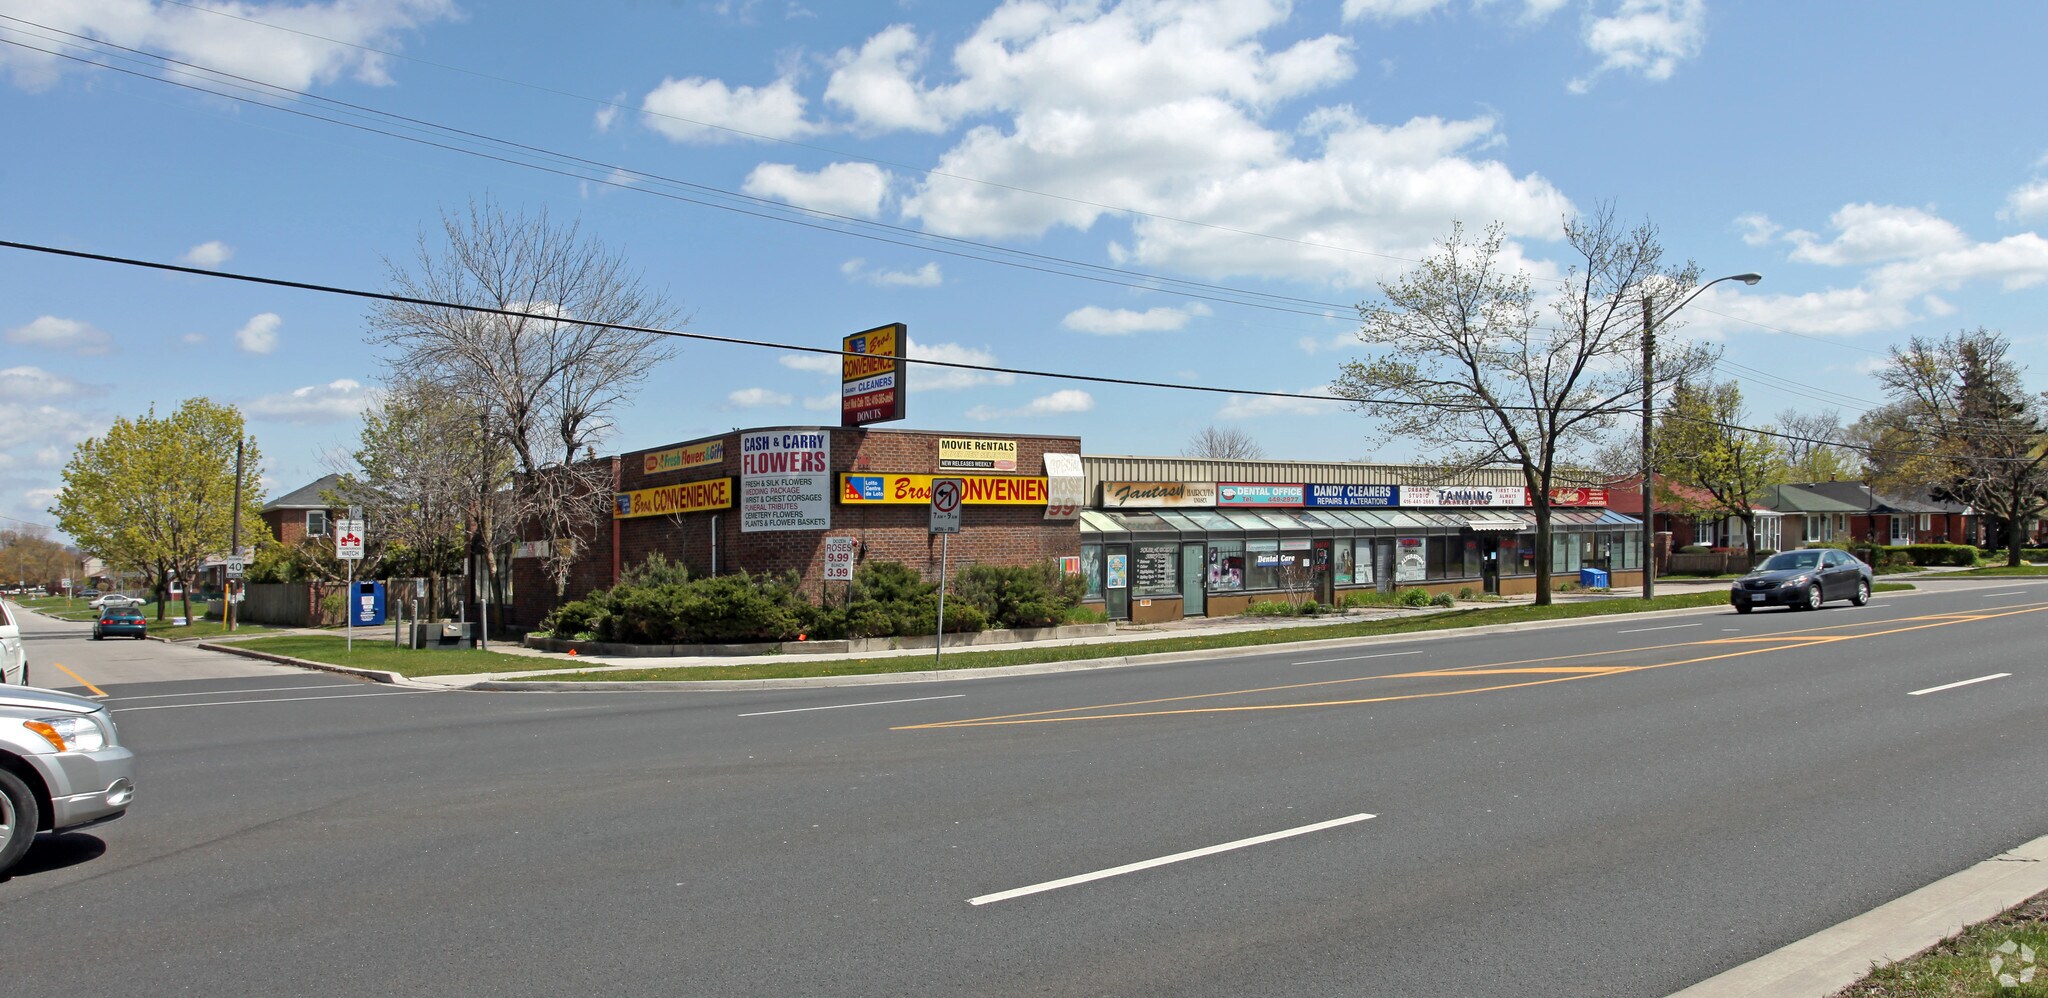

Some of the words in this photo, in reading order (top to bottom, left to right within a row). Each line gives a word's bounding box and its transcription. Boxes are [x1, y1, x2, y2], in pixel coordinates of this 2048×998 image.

[844, 350, 893, 377] CONVENIENCE
[858, 376, 892, 392] CLEANERS
[857, 408, 882, 422] DONUTS
[744, 436, 770, 452] CASH
[773, 437, 780, 447] &
[782, 434, 825, 449] CARRY
[941, 440, 972, 450] MOVIE
[974, 441, 1015, 452] RENTALS
[664, 450, 681, 467] Fresh
[681, 448, 705, 465] Flowers
[743, 451, 826, 475] FLOWERS
[745, 480, 760, 488] FRESH
[766, 479, 780, 487] SILK
[781, 478, 812, 486] FLOWERS
[745, 488, 769, 496] WEDDING
[770, 486, 801, 495] PACKAGE
[961, 477, 1048, 501] ONVENIEN
[1237, 487, 1270, 496] DENTAL
[1272, 487, 1302, 496] OFFICE
[1313, 485, 1344, 497] DANDY
[1346, 485, 1391, 497] CLEANERS
[653, 481, 725, 512] CONVENIENCE
[745, 496, 760, 504] WRIST
[765, 495, 787, 503] CHEST
[787, 493, 822, 502] CORSAGES
[1114, 484, 1185, 506] Fantasy
[1438, 490, 1493, 501] TANNING
[1317, 497, 1343, 505] REPAIRS
[1343, 497, 1349, 505] &
[1349, 497, 1388, 505] ALTERATIONS
[744, 504, 767, 512] FUNERAL
[768, 502, 798, 510] TRIBUTES
[745, 511, 771, 519] CEMETERY
[772, 510, 803, 518] FLOWERS
[745, 519, 763, 528] PLANTS
[769, 518, 796, 526] FLOWER
[797, 517, 826, 526] BASKETS
[826, 543, 852, 552] ROSES
[828, 553, 849, 562] 9.99
[1280, 554, 1295, 562] Care
[228, 562, 242, 571] 40
[827, 568, 848, 577] 3.99
